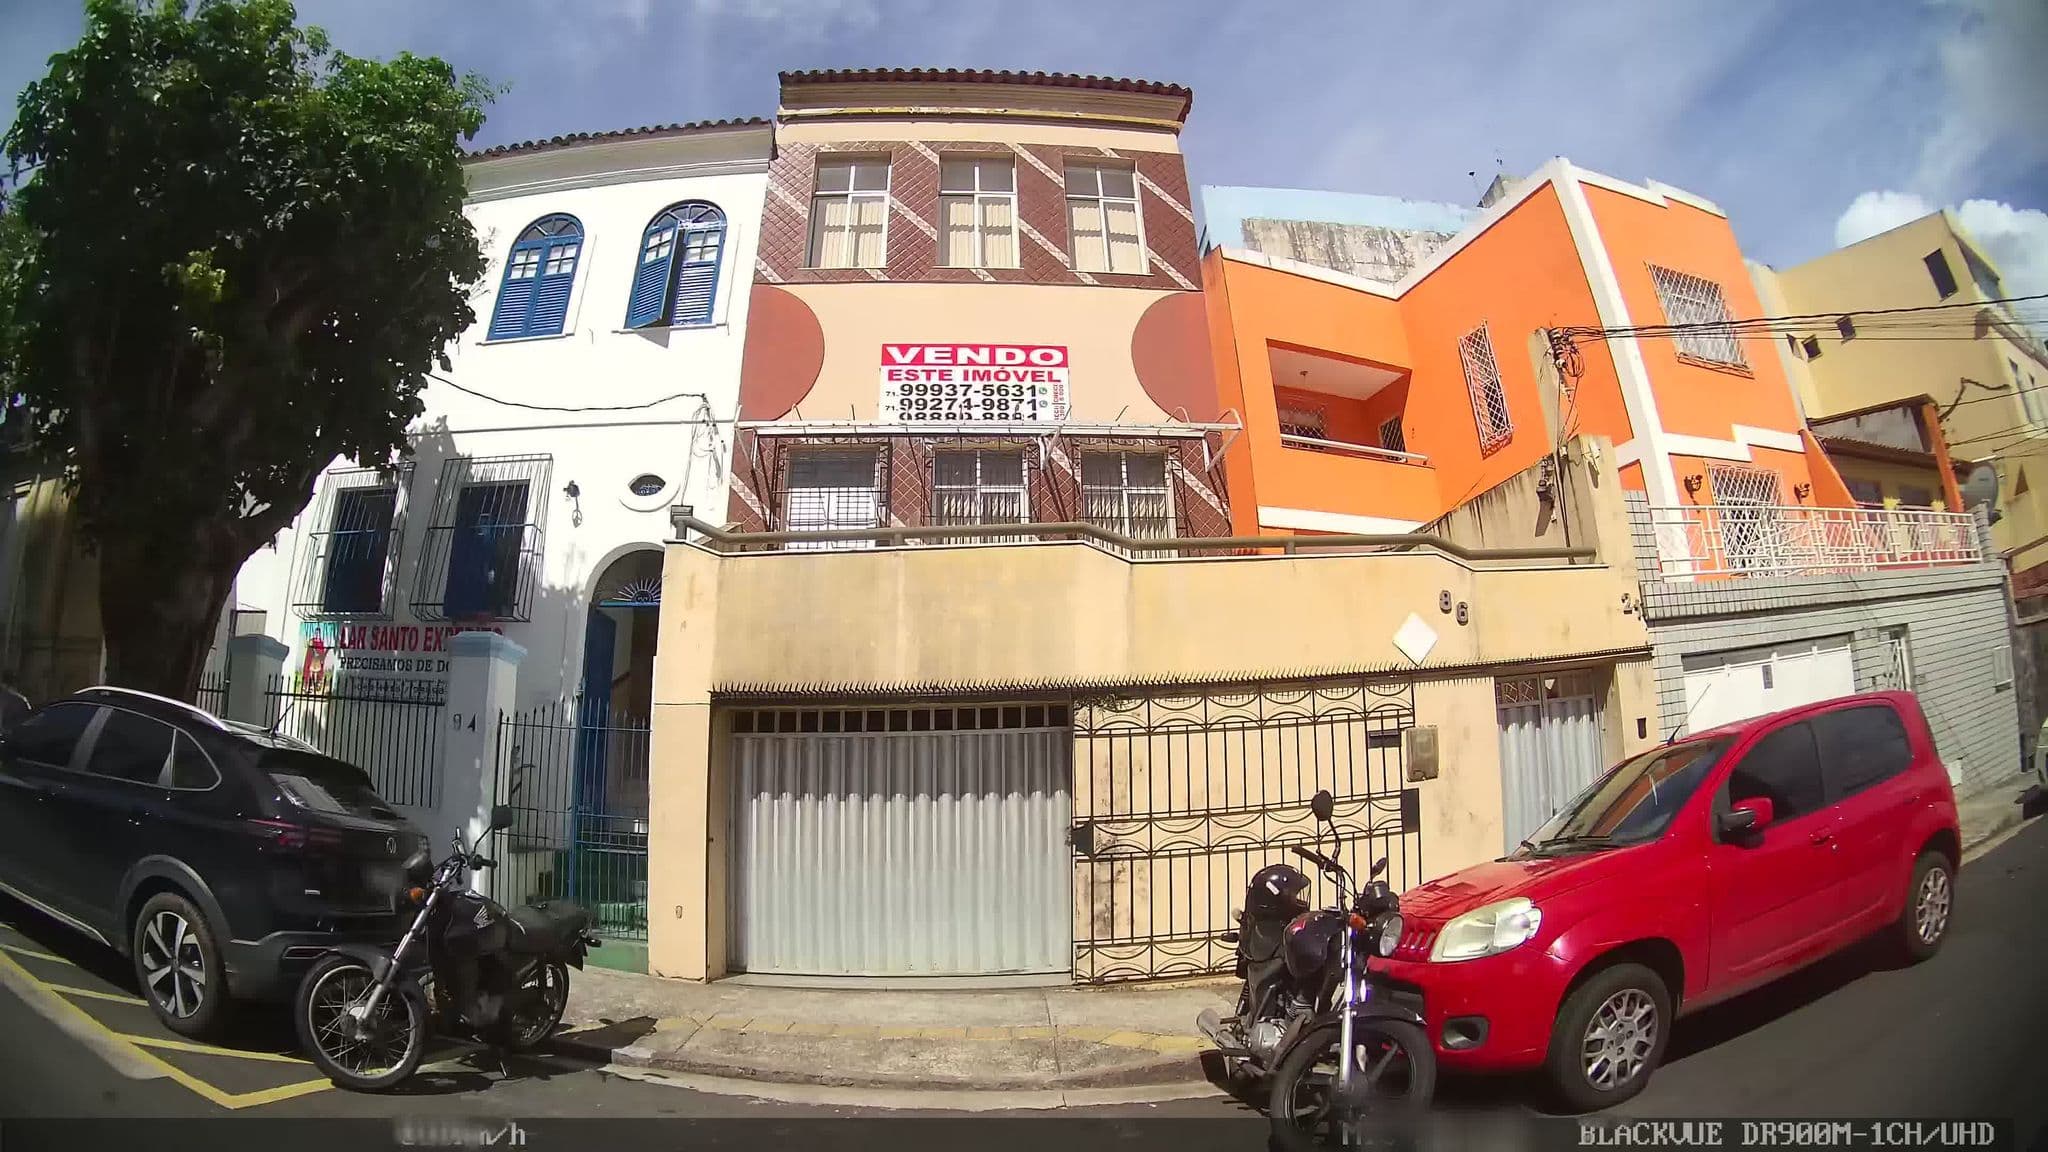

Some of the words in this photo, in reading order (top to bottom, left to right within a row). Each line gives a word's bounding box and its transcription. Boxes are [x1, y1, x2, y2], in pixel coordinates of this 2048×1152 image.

[886, 346, 1063, 366] VENDO
[888, 369, 953, 382] ESTE
[963, 367, 1061, 383] IMÓVEL
[340, 625, 366, 650] LAR
[371, 626, 419, 651] SANTO
[340, 657, 413, 673] PRECISAMOS
[416, 659, 432, 673] DE
